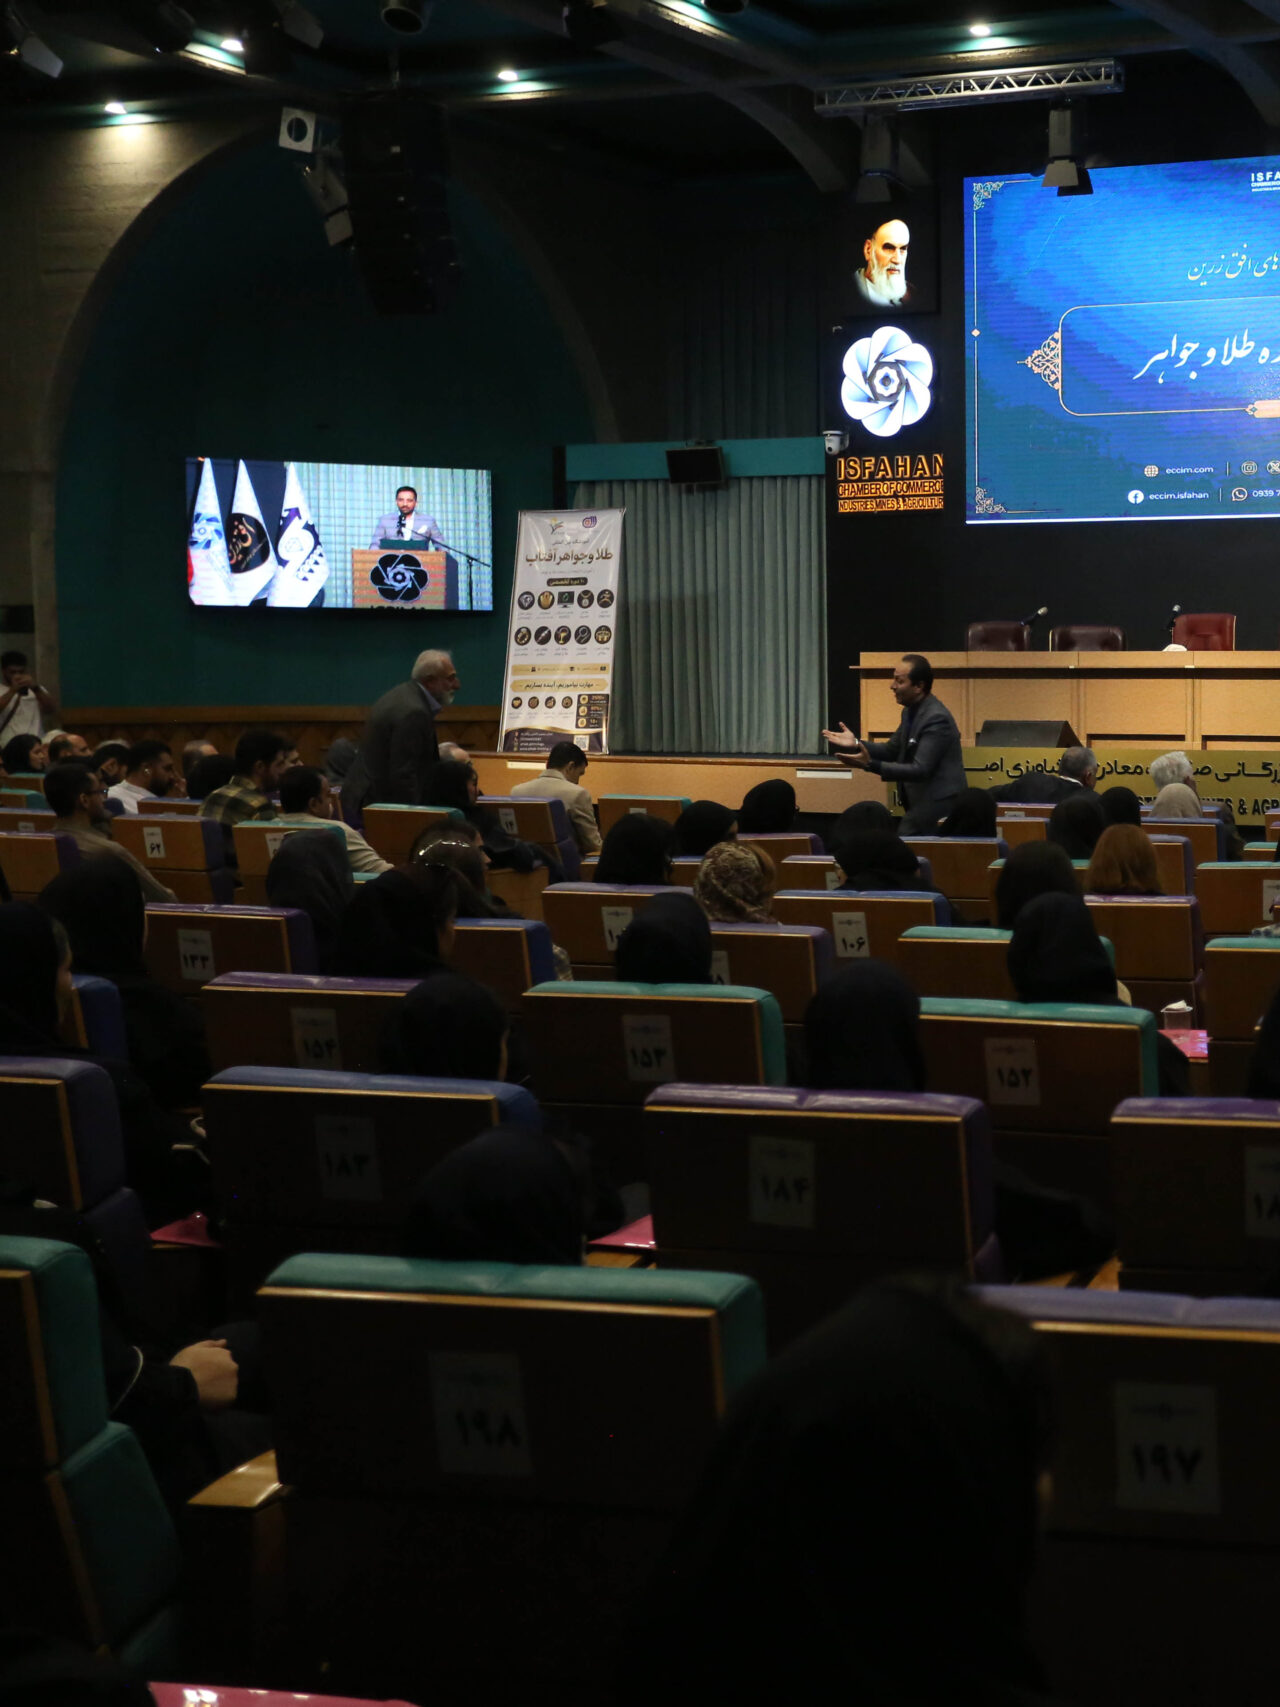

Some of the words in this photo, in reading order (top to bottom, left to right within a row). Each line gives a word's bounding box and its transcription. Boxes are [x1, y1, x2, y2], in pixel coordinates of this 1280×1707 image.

[1187, 254, 1226, 286] زرین
[1225, 243, 1253, 278] افق
[1201, 344, 1217, 368] و
[1220, 327, 1256, 366] طلا
[1132, 332, 1201, 384] جواهر
[837, 453, 944, 480] ISFAHAN
[1165, 465, 1214, 475] eccim.com
[838, 481, 880, 498] CHAMBER
[881, 481, 896, 496] OF
[1149, 491, 1209, 501] eccim.isfahan
[1252, 489, 1274, 498] 0939
[556, 550, 587, 566] جواهر
[596, 548, 614, 561] طلا
[1239, 799, 1248, 815] &
[842, 936, 865, 951] ۱۰۶
[455, 1409, 522, 1447] ۱۹۸
[1133, 1443, 1202, 1483] ۱۹۷
